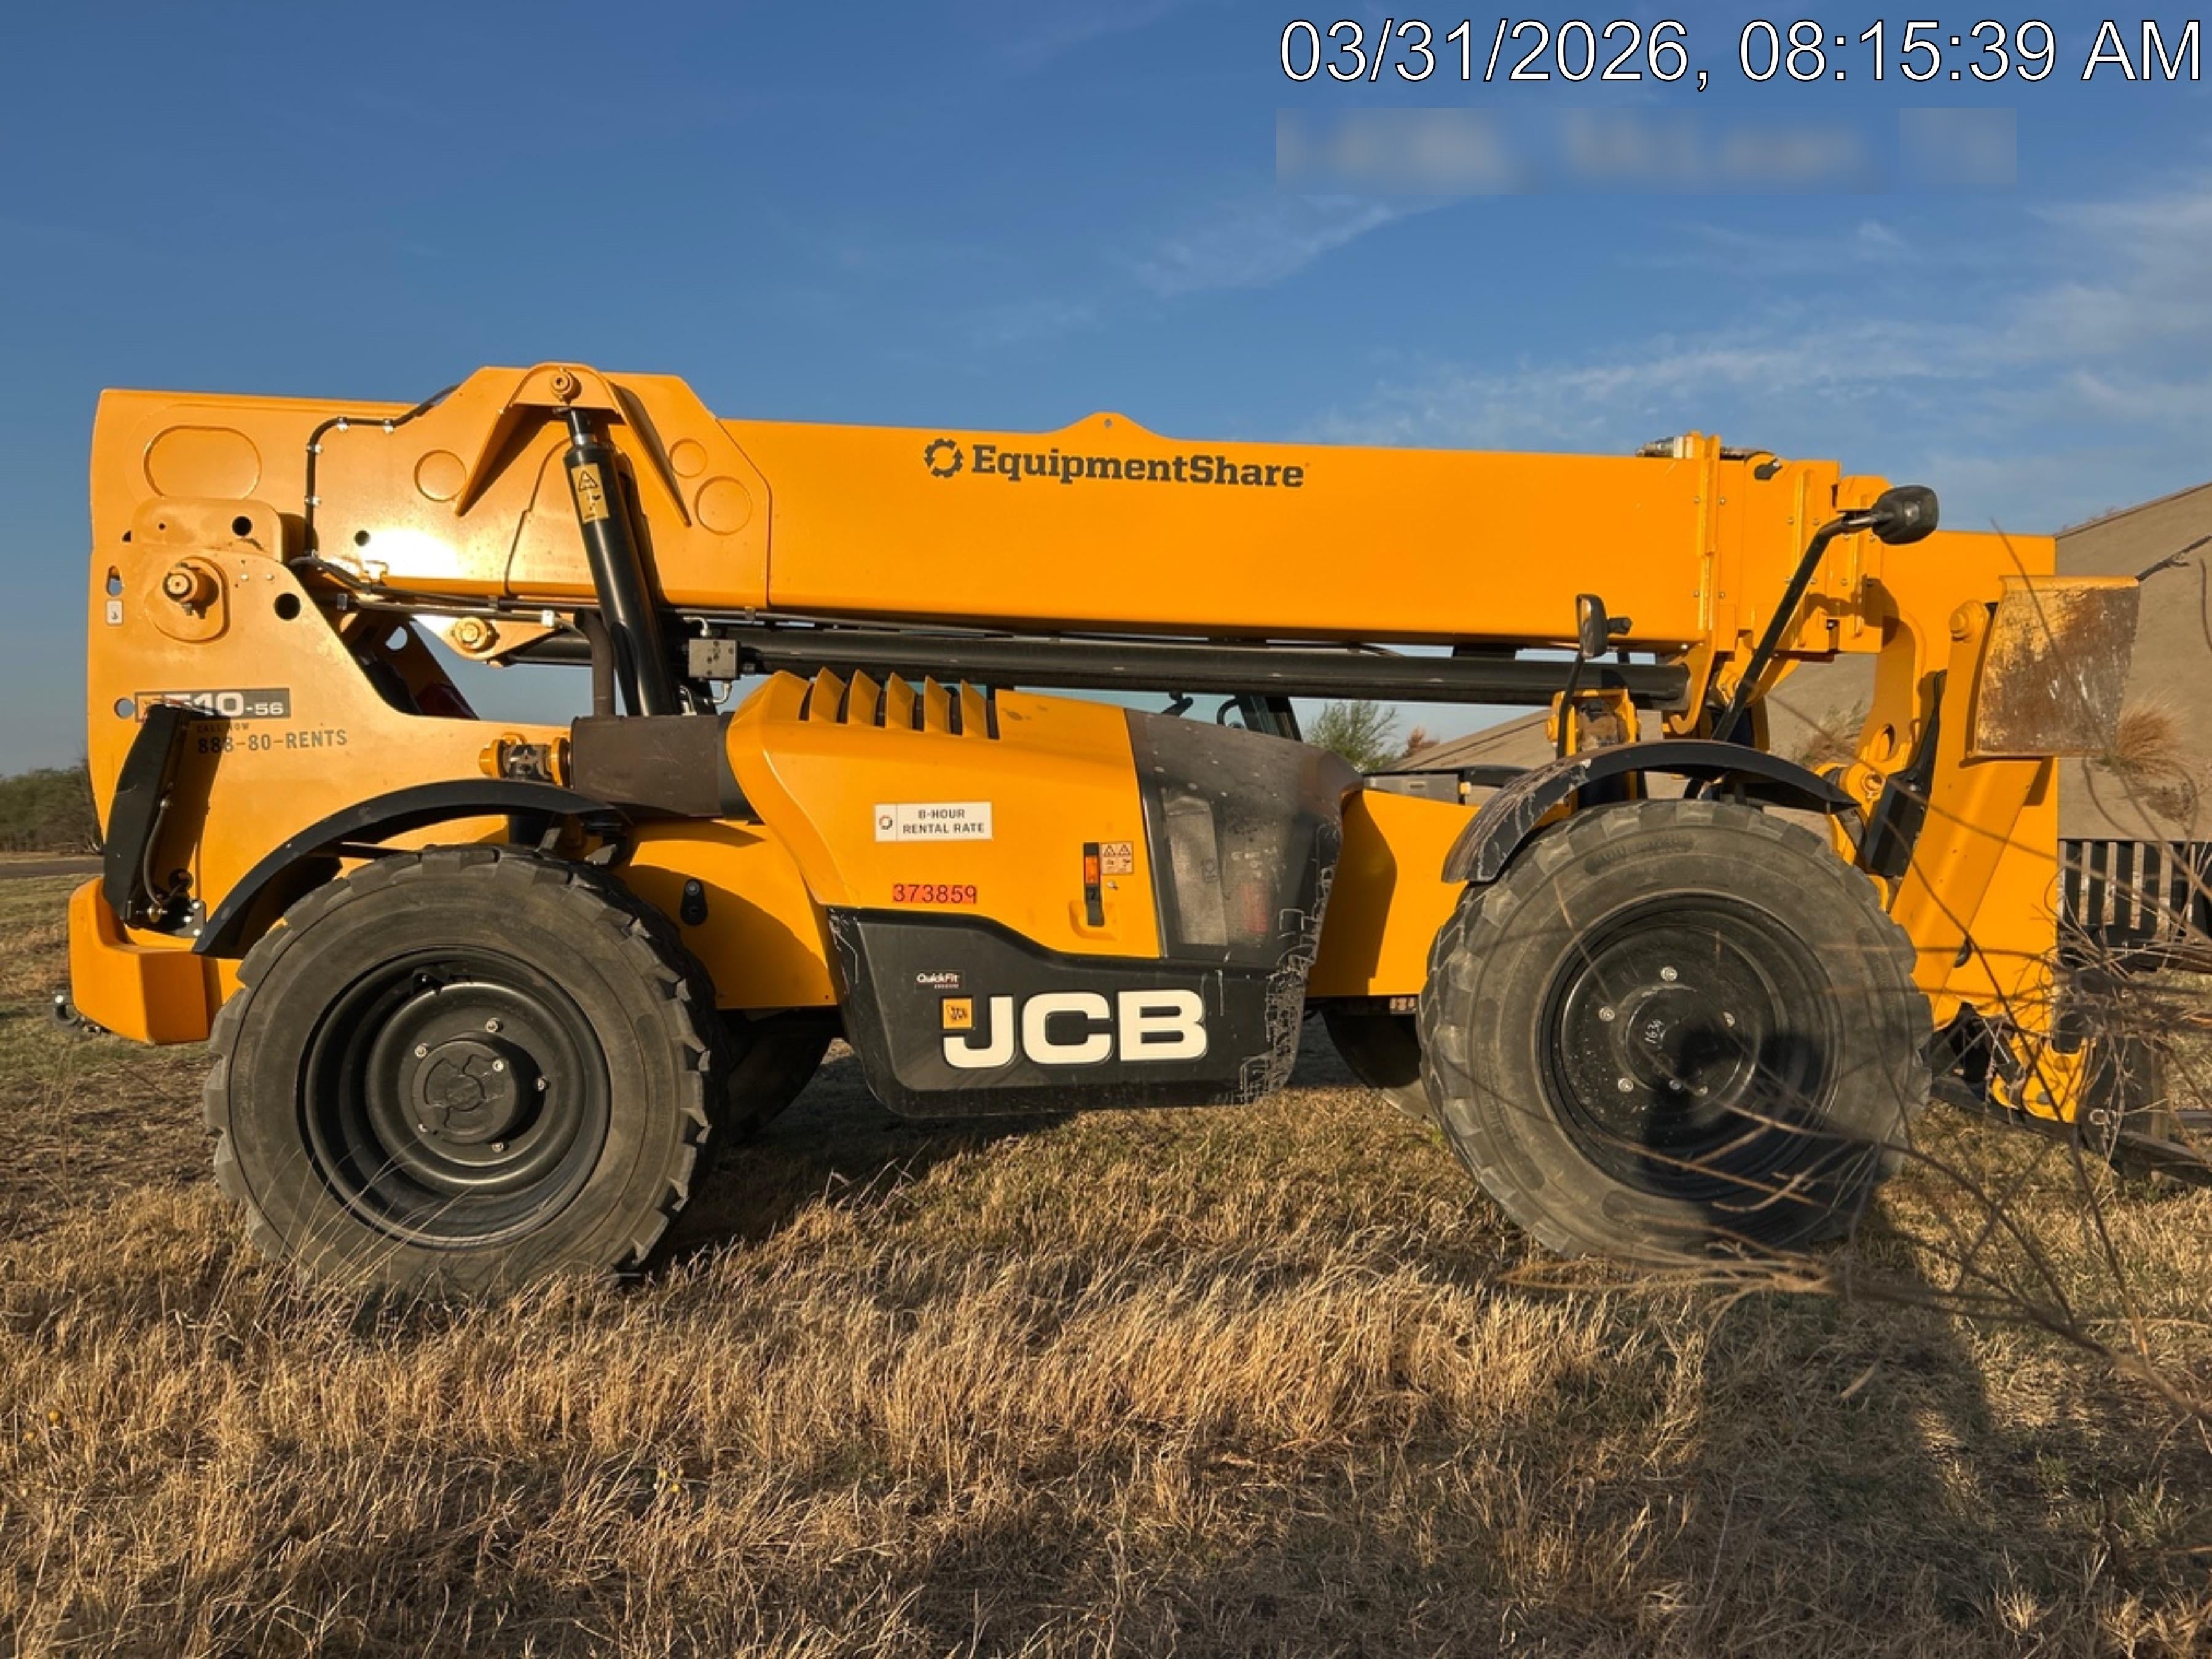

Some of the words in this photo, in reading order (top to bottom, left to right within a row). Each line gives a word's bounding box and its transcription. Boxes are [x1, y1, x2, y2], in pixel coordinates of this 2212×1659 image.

[971, 444, 1304, 487] EquipmentShare
[197, 729, 347, 754] 888-80-RENTS
[903, 823, 949, 834] RENTAL
[954, 822, 984, 833] RATE
[893, 883, 978, 904] 373859
[943, 989, 1207, 1068] JCB
